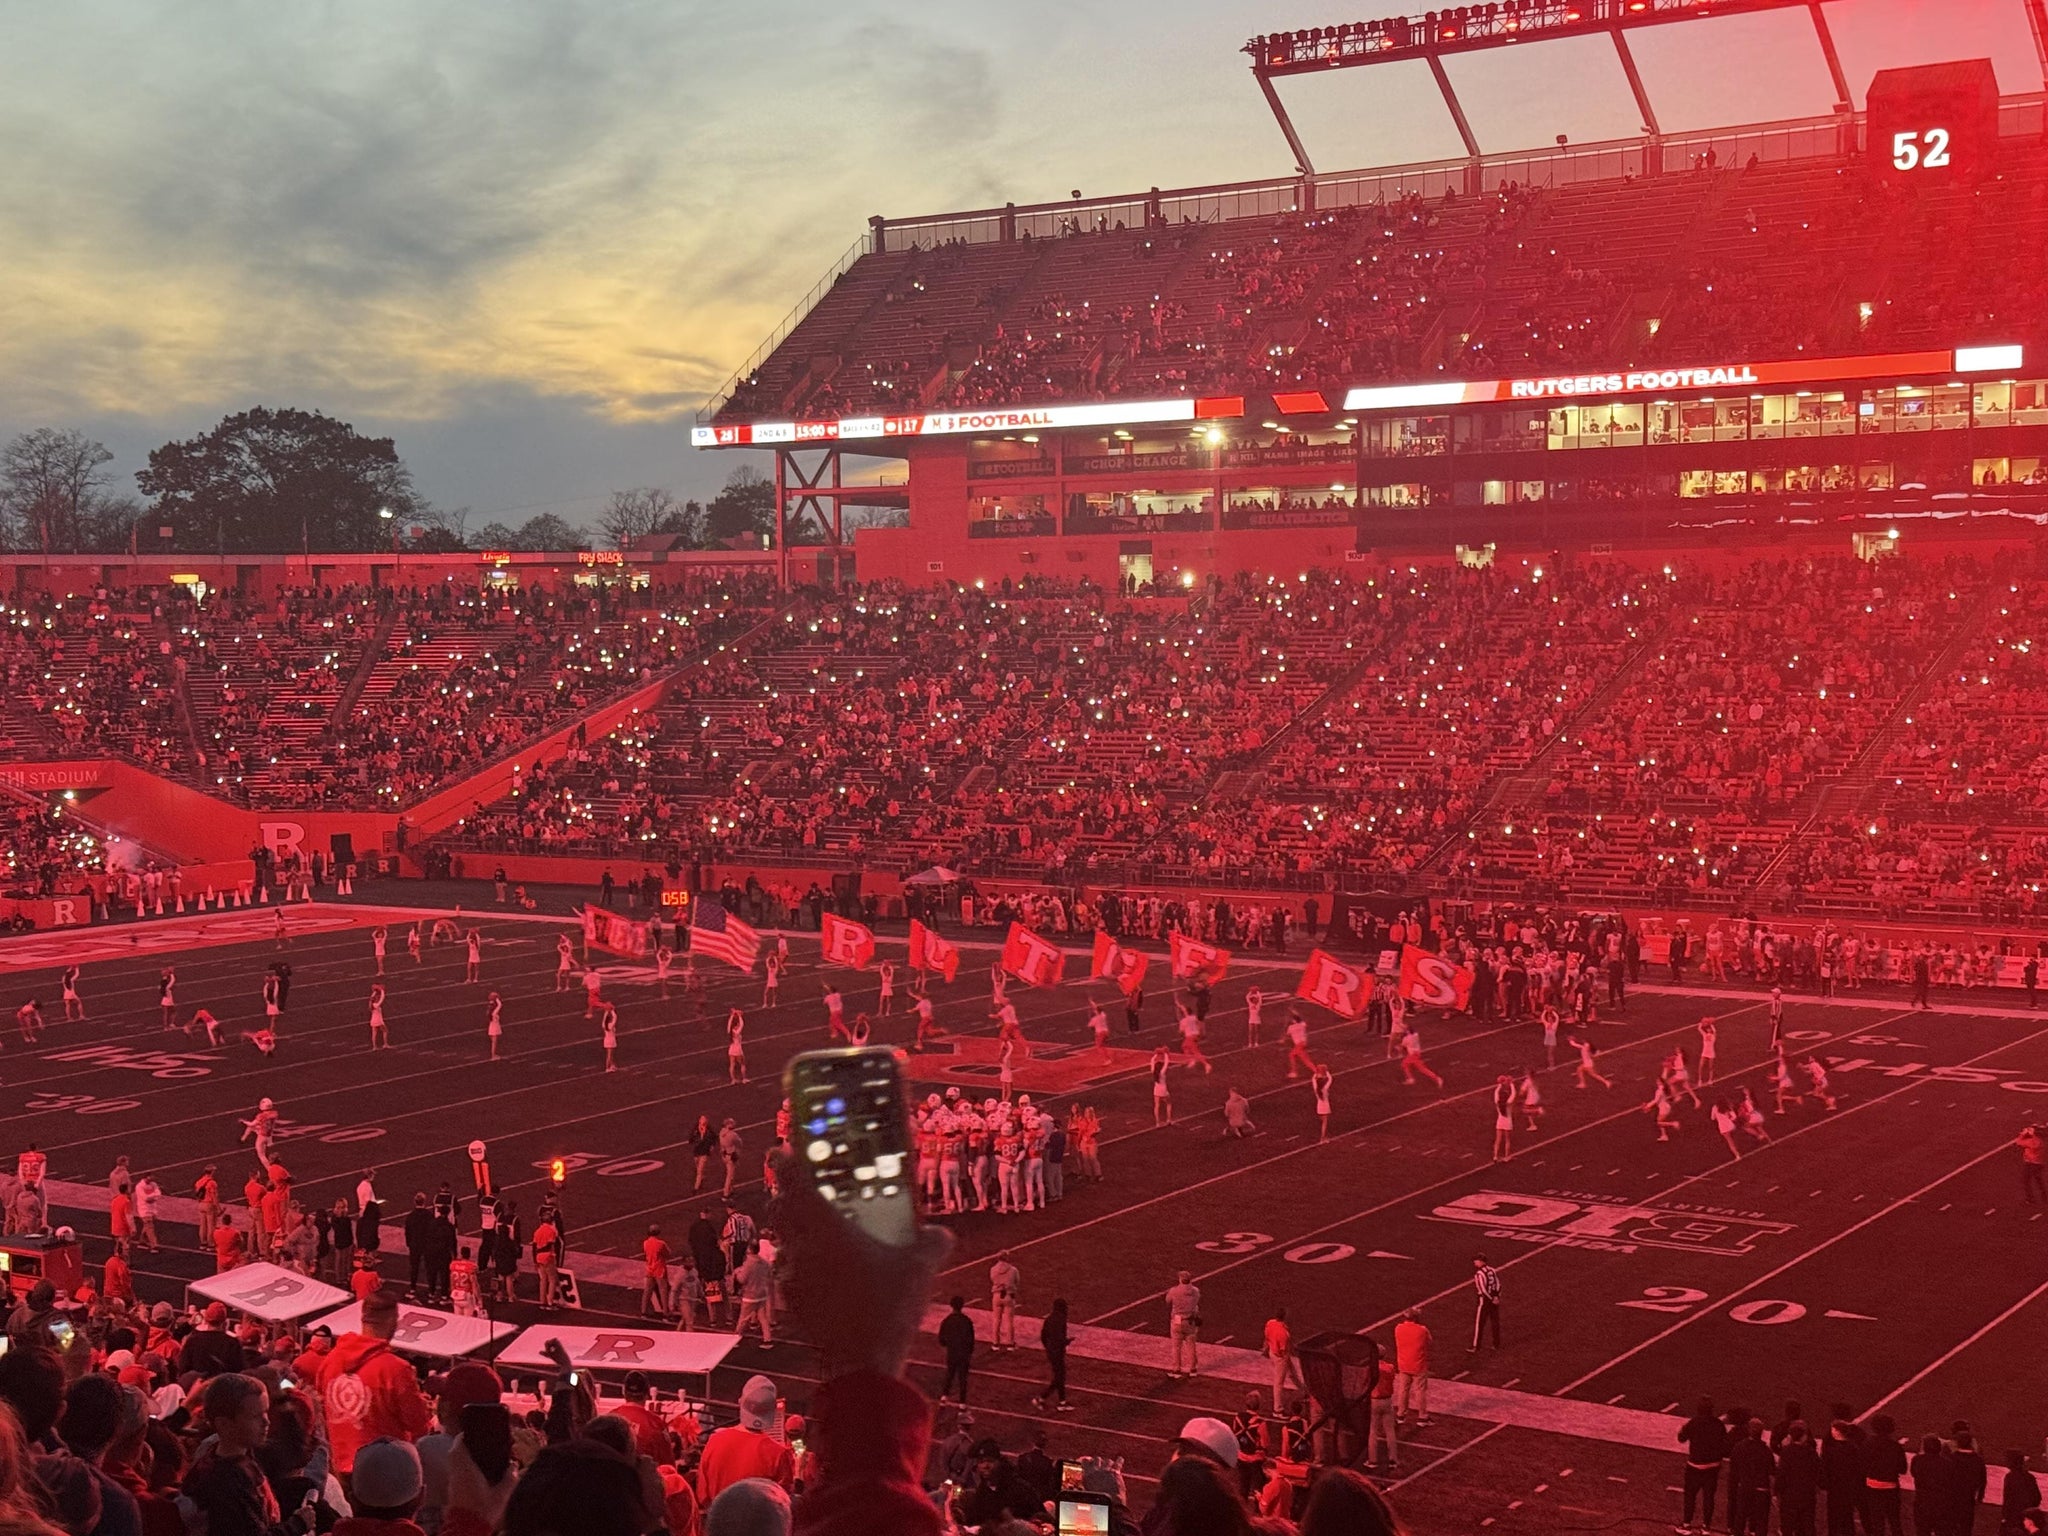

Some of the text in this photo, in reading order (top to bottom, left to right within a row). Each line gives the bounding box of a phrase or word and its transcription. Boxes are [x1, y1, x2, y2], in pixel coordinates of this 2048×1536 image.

[1893, 128, 1950, 170] 52
[1511, 367, 1758, 397] RUTGERS FOOTBALL
[797, 424, 825, 437] 15:00
[904, 419, 917, 432] 17
[959, 412, 1053, 428] FOOTBALL
[579, 552, 623, 563] FRY SHACK
[29, 770, 98, 785] STADIUM
[260, 822, 305, 863] R
[53, 900, 77, 925] R
[829, 920, 869, 962] R
[1018, 932, 1061, 984] T
[1309, 957, 1360, 1016] R
[1411, 957, 1457, 1006] S
[1195, 1231, 1356, 1265] 30
[231, 1277, 305, 1306] R
[1616, 1286, 1807, 1325] 20
[574, 1334, 655, 1363] R
